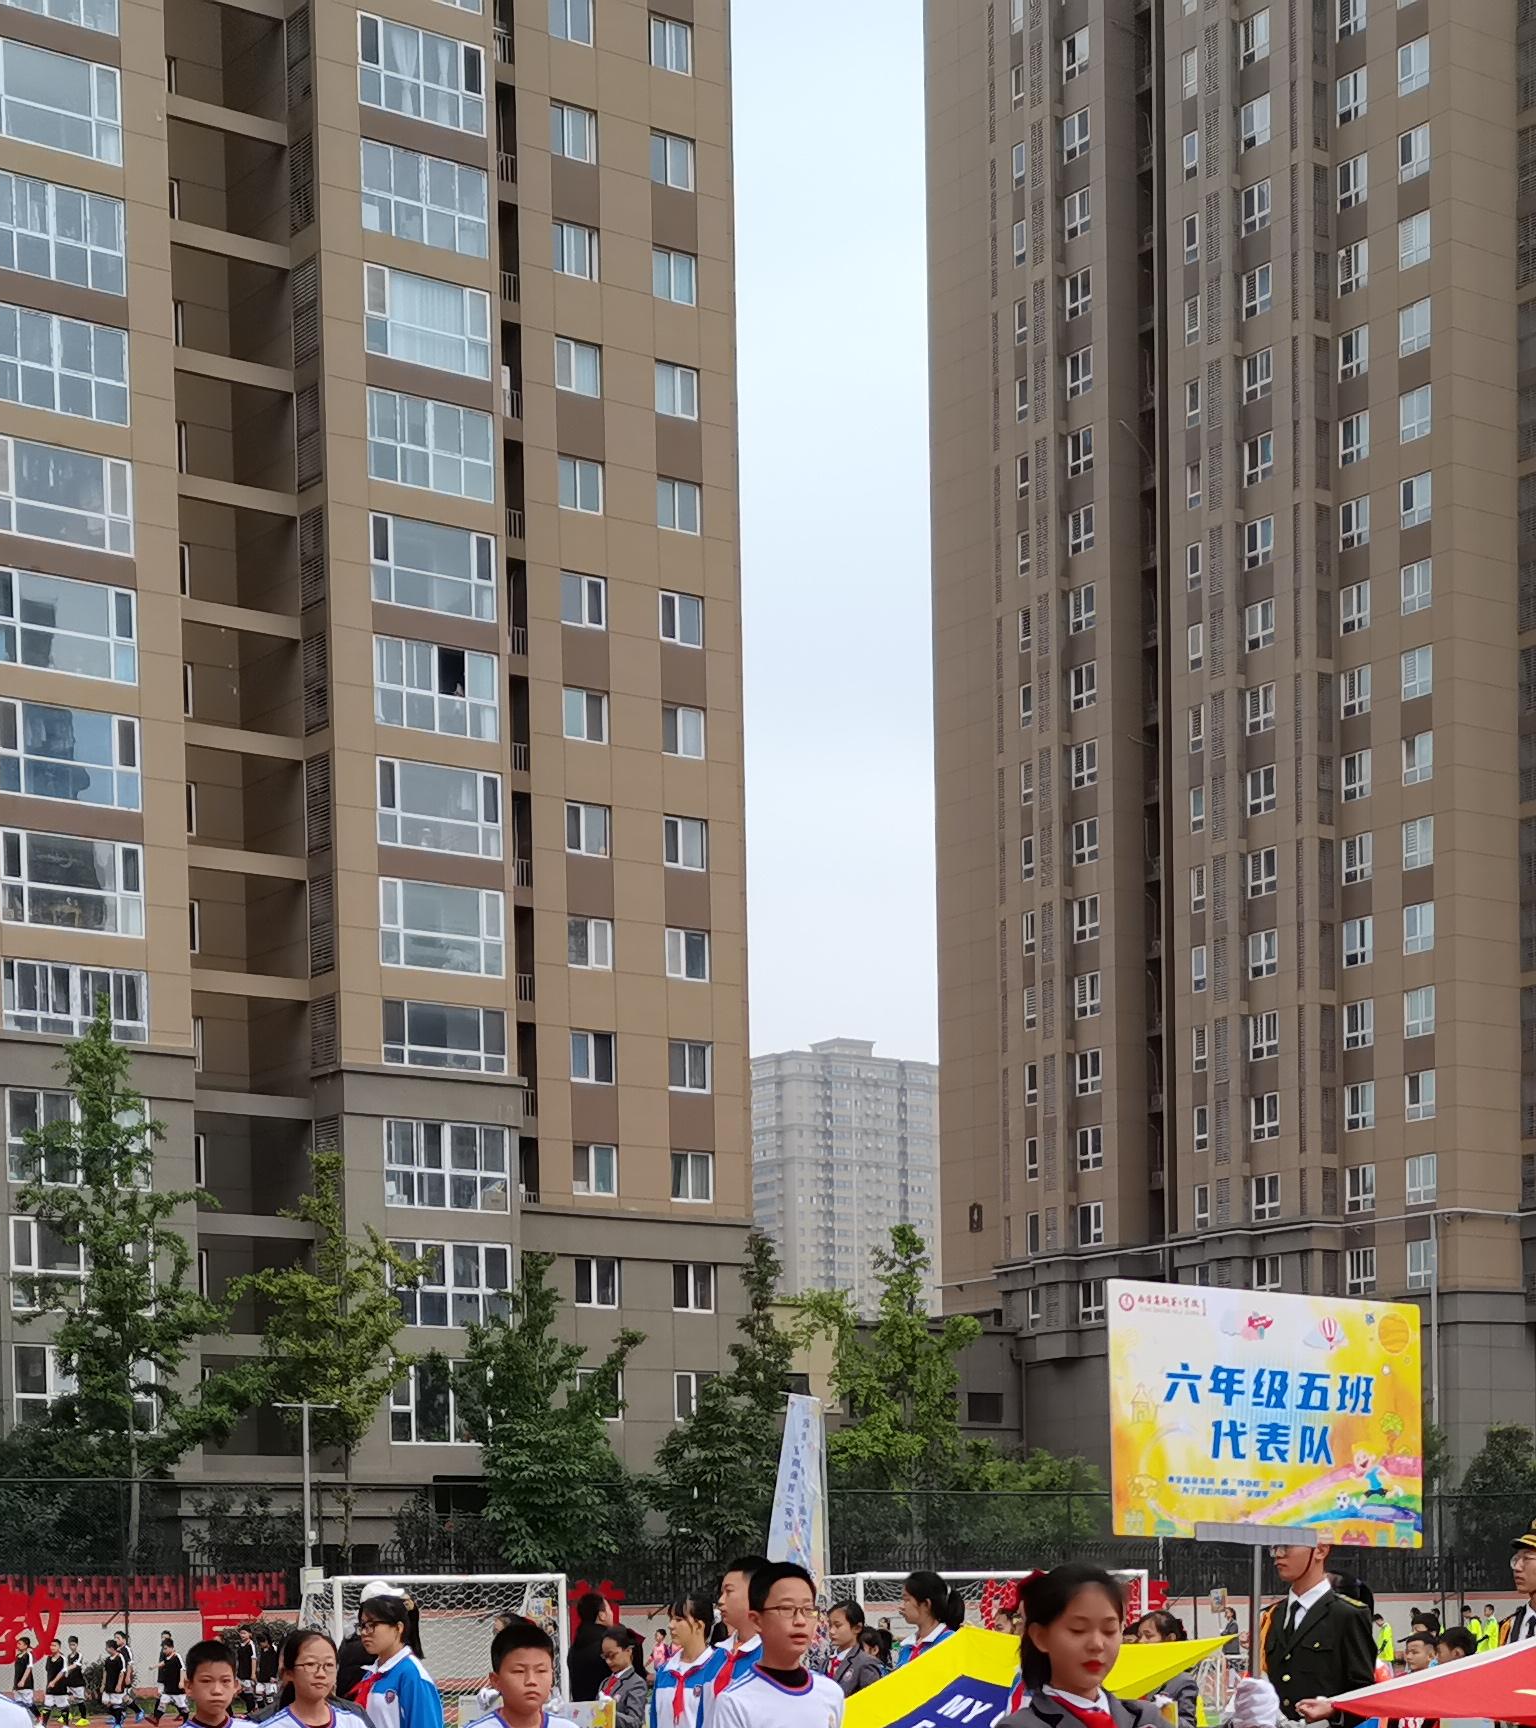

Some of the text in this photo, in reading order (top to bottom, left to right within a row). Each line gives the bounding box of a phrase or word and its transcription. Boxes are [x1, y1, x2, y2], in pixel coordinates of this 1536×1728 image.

[1163, 1362, 1375, 1415] 六年级五班
[1210, 1419, 1334, 1467] 代表队
[936, 1694, 993, 1724] MY
